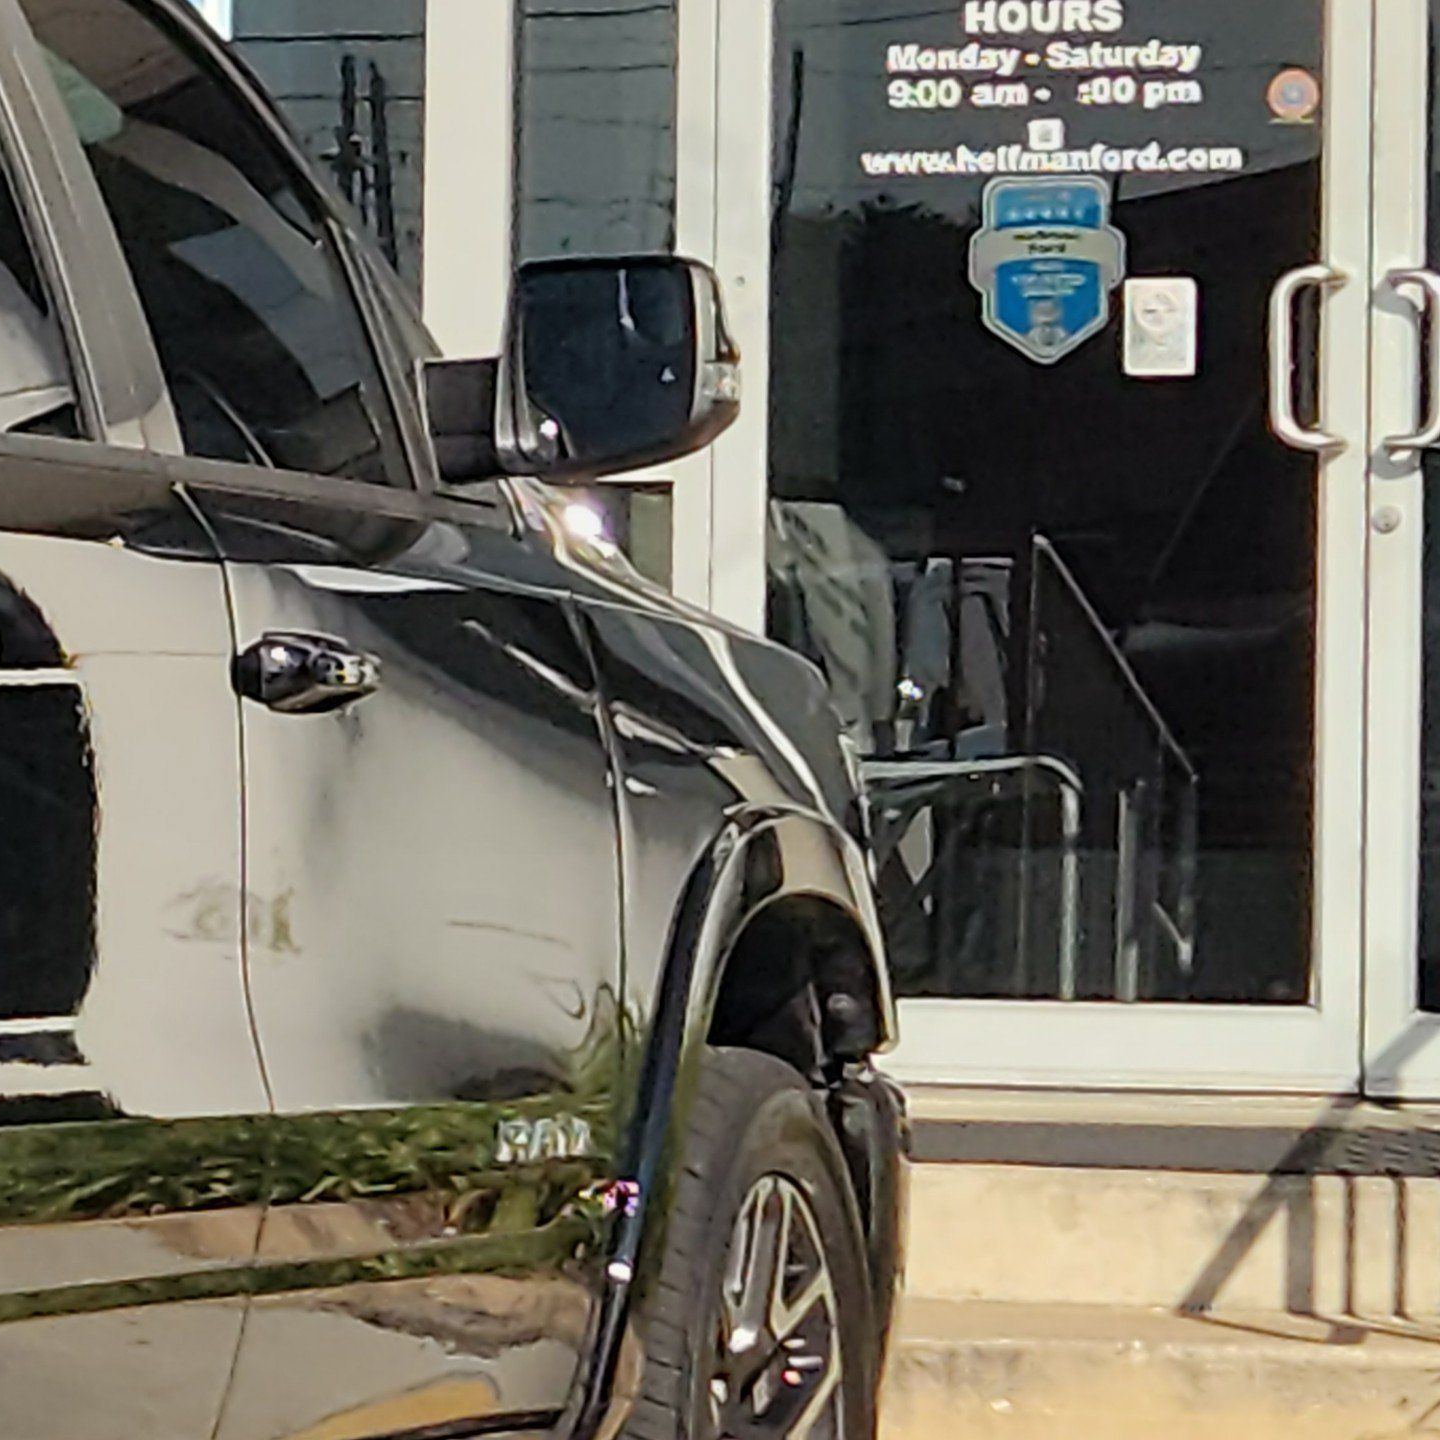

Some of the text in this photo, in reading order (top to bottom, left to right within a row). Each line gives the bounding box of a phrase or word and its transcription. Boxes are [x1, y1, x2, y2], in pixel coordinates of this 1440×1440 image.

[887, 43, 1021, 75] Monday
[1045, 39, 1202, 73] Saturday
[887, 79, 962, 108] 9:00
[970, 82, 1029, 106] am
[1143, 80, 1203, 109] pm
[860, 142, 1243, 175] www.helfmanford.com
